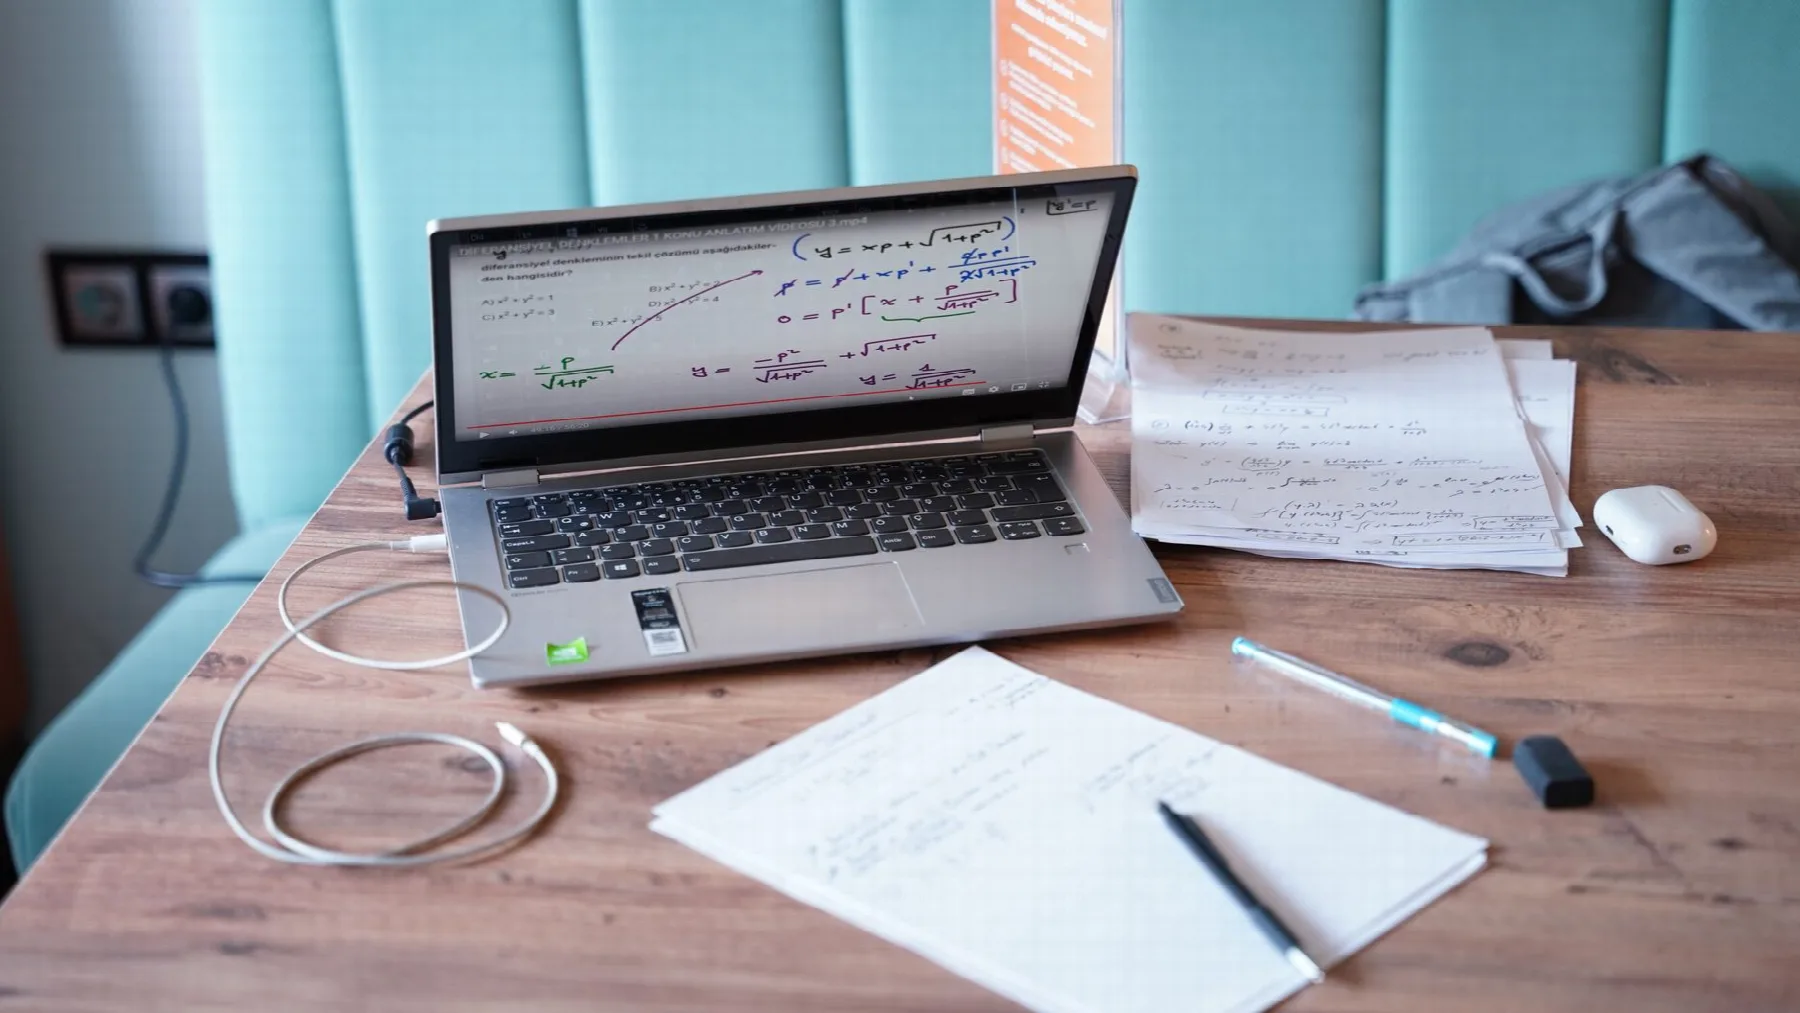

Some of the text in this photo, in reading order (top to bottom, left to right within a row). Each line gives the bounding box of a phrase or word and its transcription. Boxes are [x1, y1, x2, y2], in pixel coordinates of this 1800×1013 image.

[663, 230, 701, 240] KONU
[705, 224, 765, 236] ANLATIM
[481, 243, 777, 272] diferansiyel denkleminin tekil çözümü aşağıdakiler-
[481, 270, 573, 283] den hangisidir?
[506, 540, 535, 548] CapsLk
